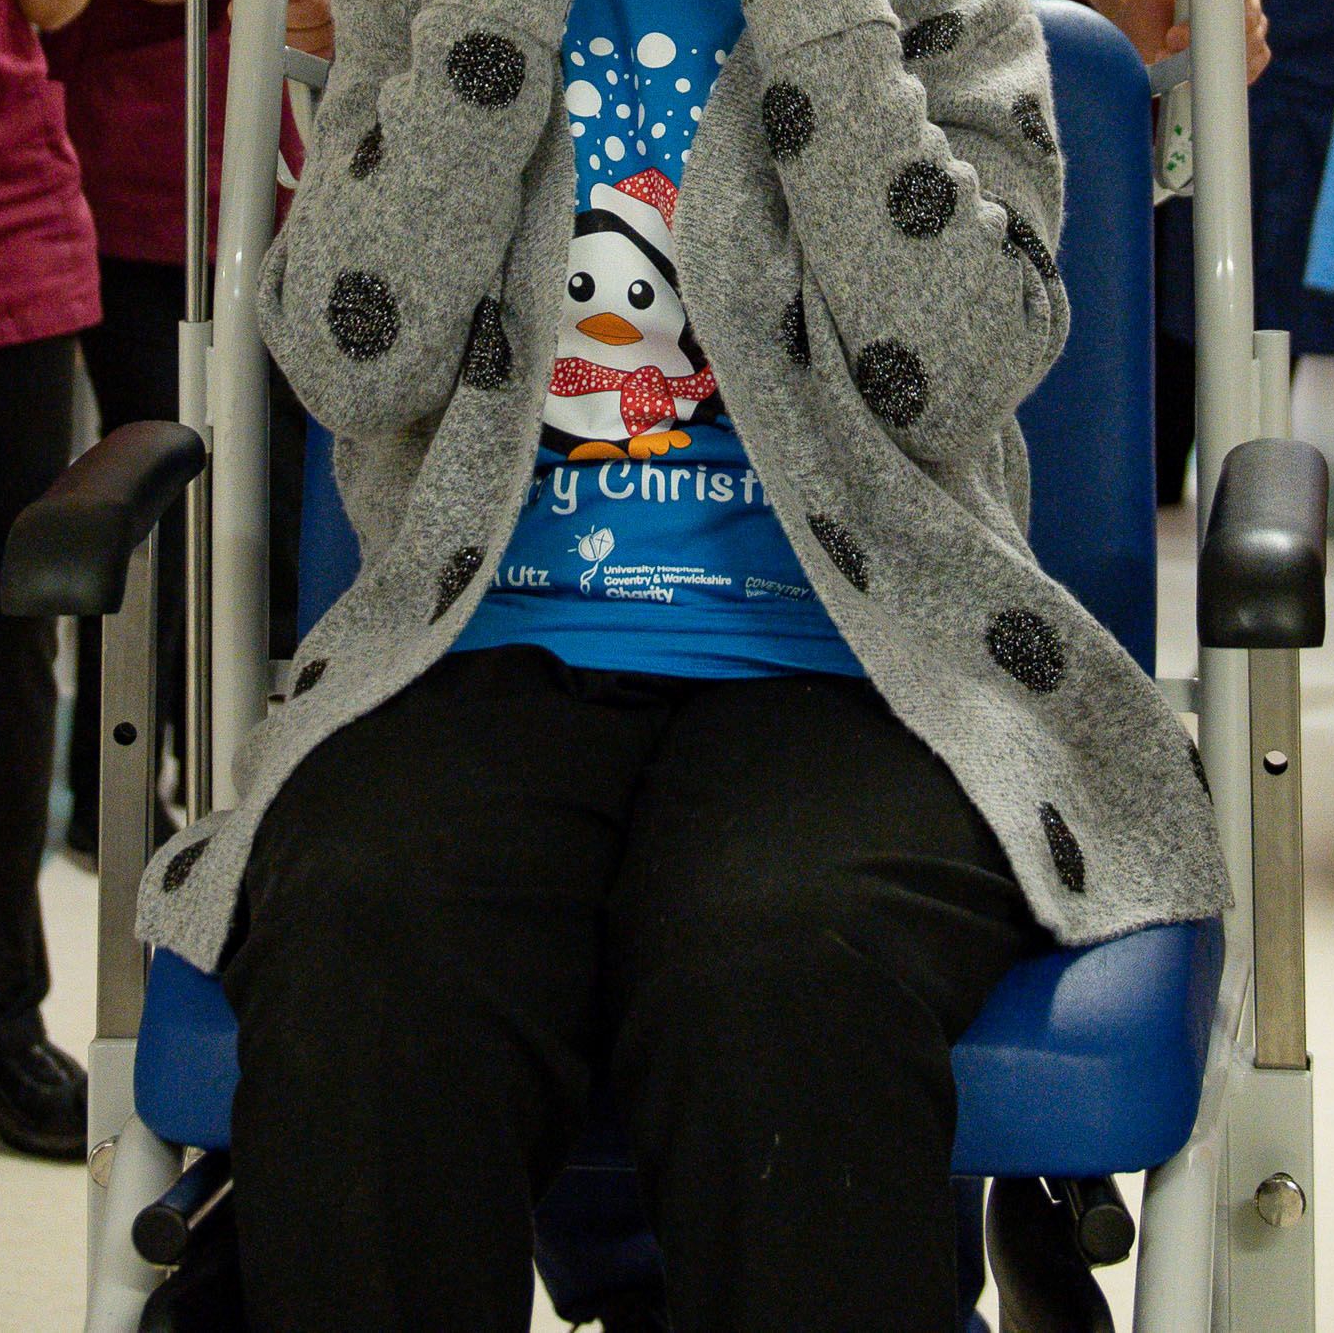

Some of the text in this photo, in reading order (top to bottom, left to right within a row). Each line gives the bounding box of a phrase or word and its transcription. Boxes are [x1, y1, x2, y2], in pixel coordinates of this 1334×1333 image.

[598, 459, 771, 506] Christ
[508, 565, 551, 587] Utz
[603, 565, 656, 575] University
[604, 574, 732, 586] Coventry & Warwickshire
[606, 585, 674, 604] Charity
[746, 576, 810, 598] COVENTRY
